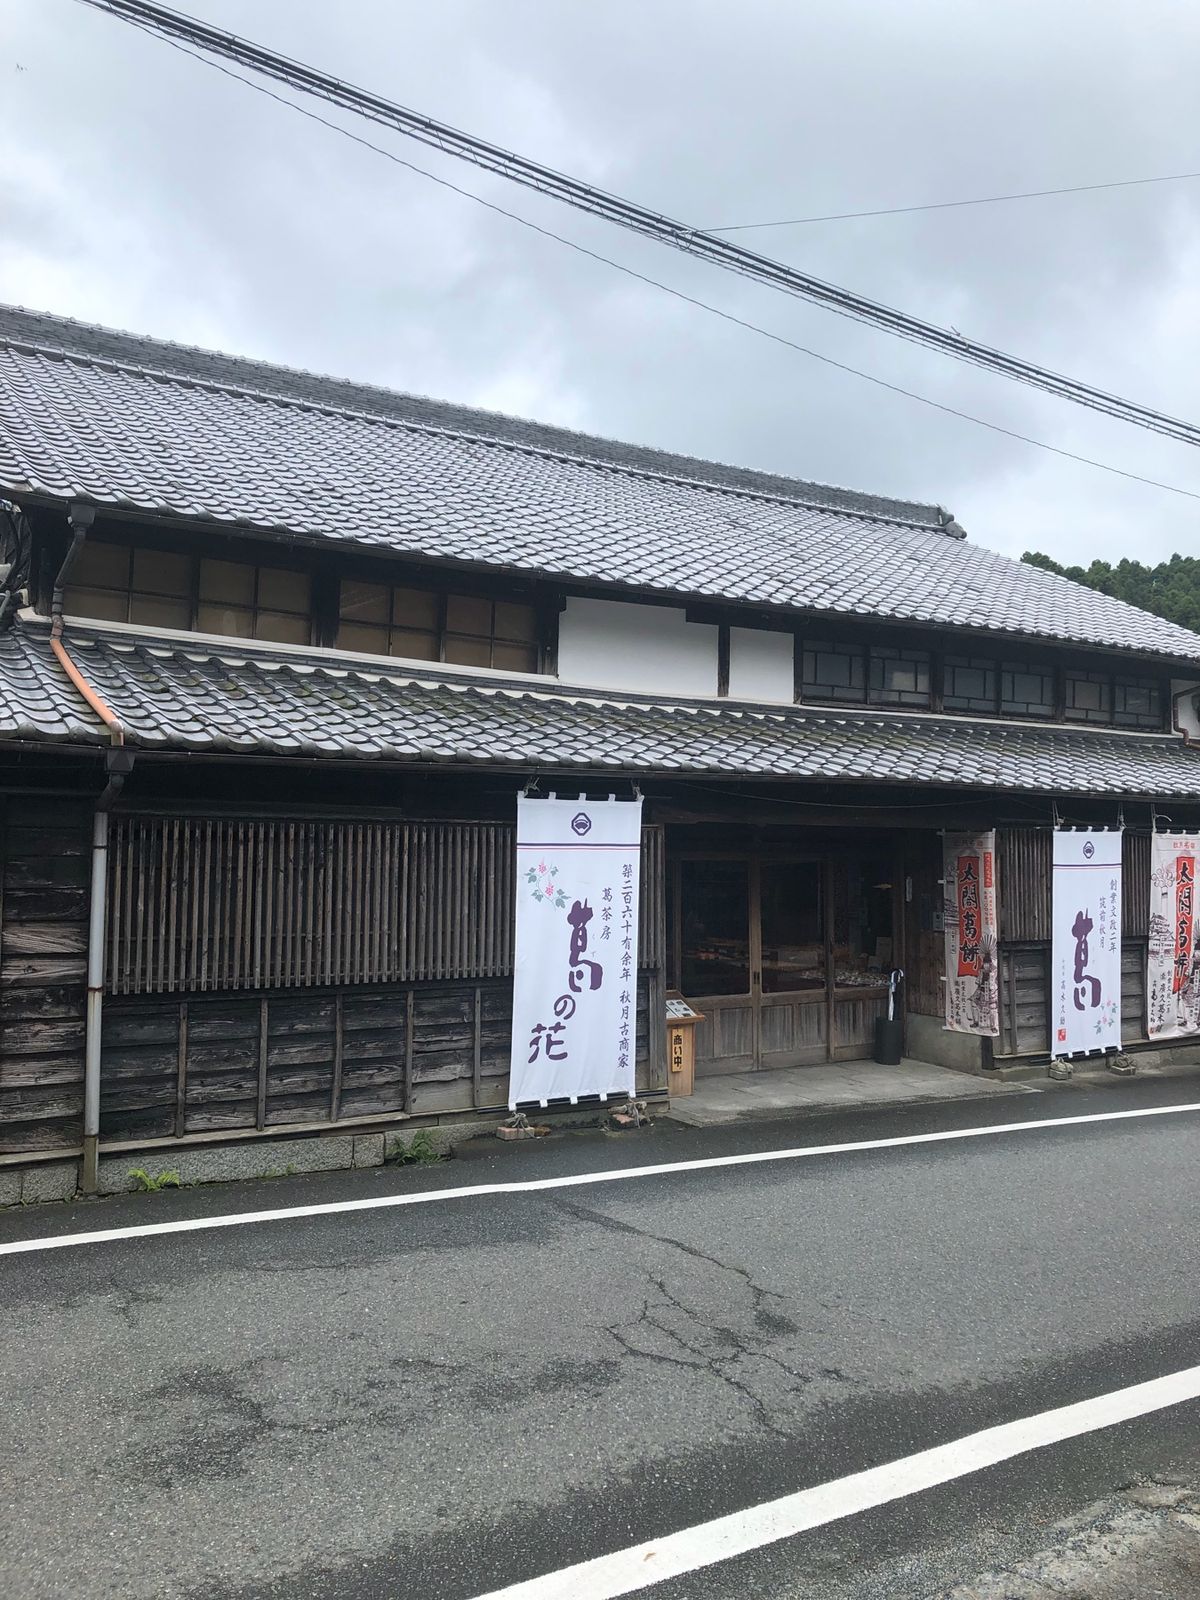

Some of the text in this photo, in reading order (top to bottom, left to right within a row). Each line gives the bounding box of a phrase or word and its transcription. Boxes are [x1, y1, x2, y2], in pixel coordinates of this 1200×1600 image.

[599, 888, 613, 940] 葛茶房
[619, 864, 634, 983] 築二百六十有余年
[617, 990, 631, 1069] 秋月古商家
[673, 1034, 683, 1068] 商い中
